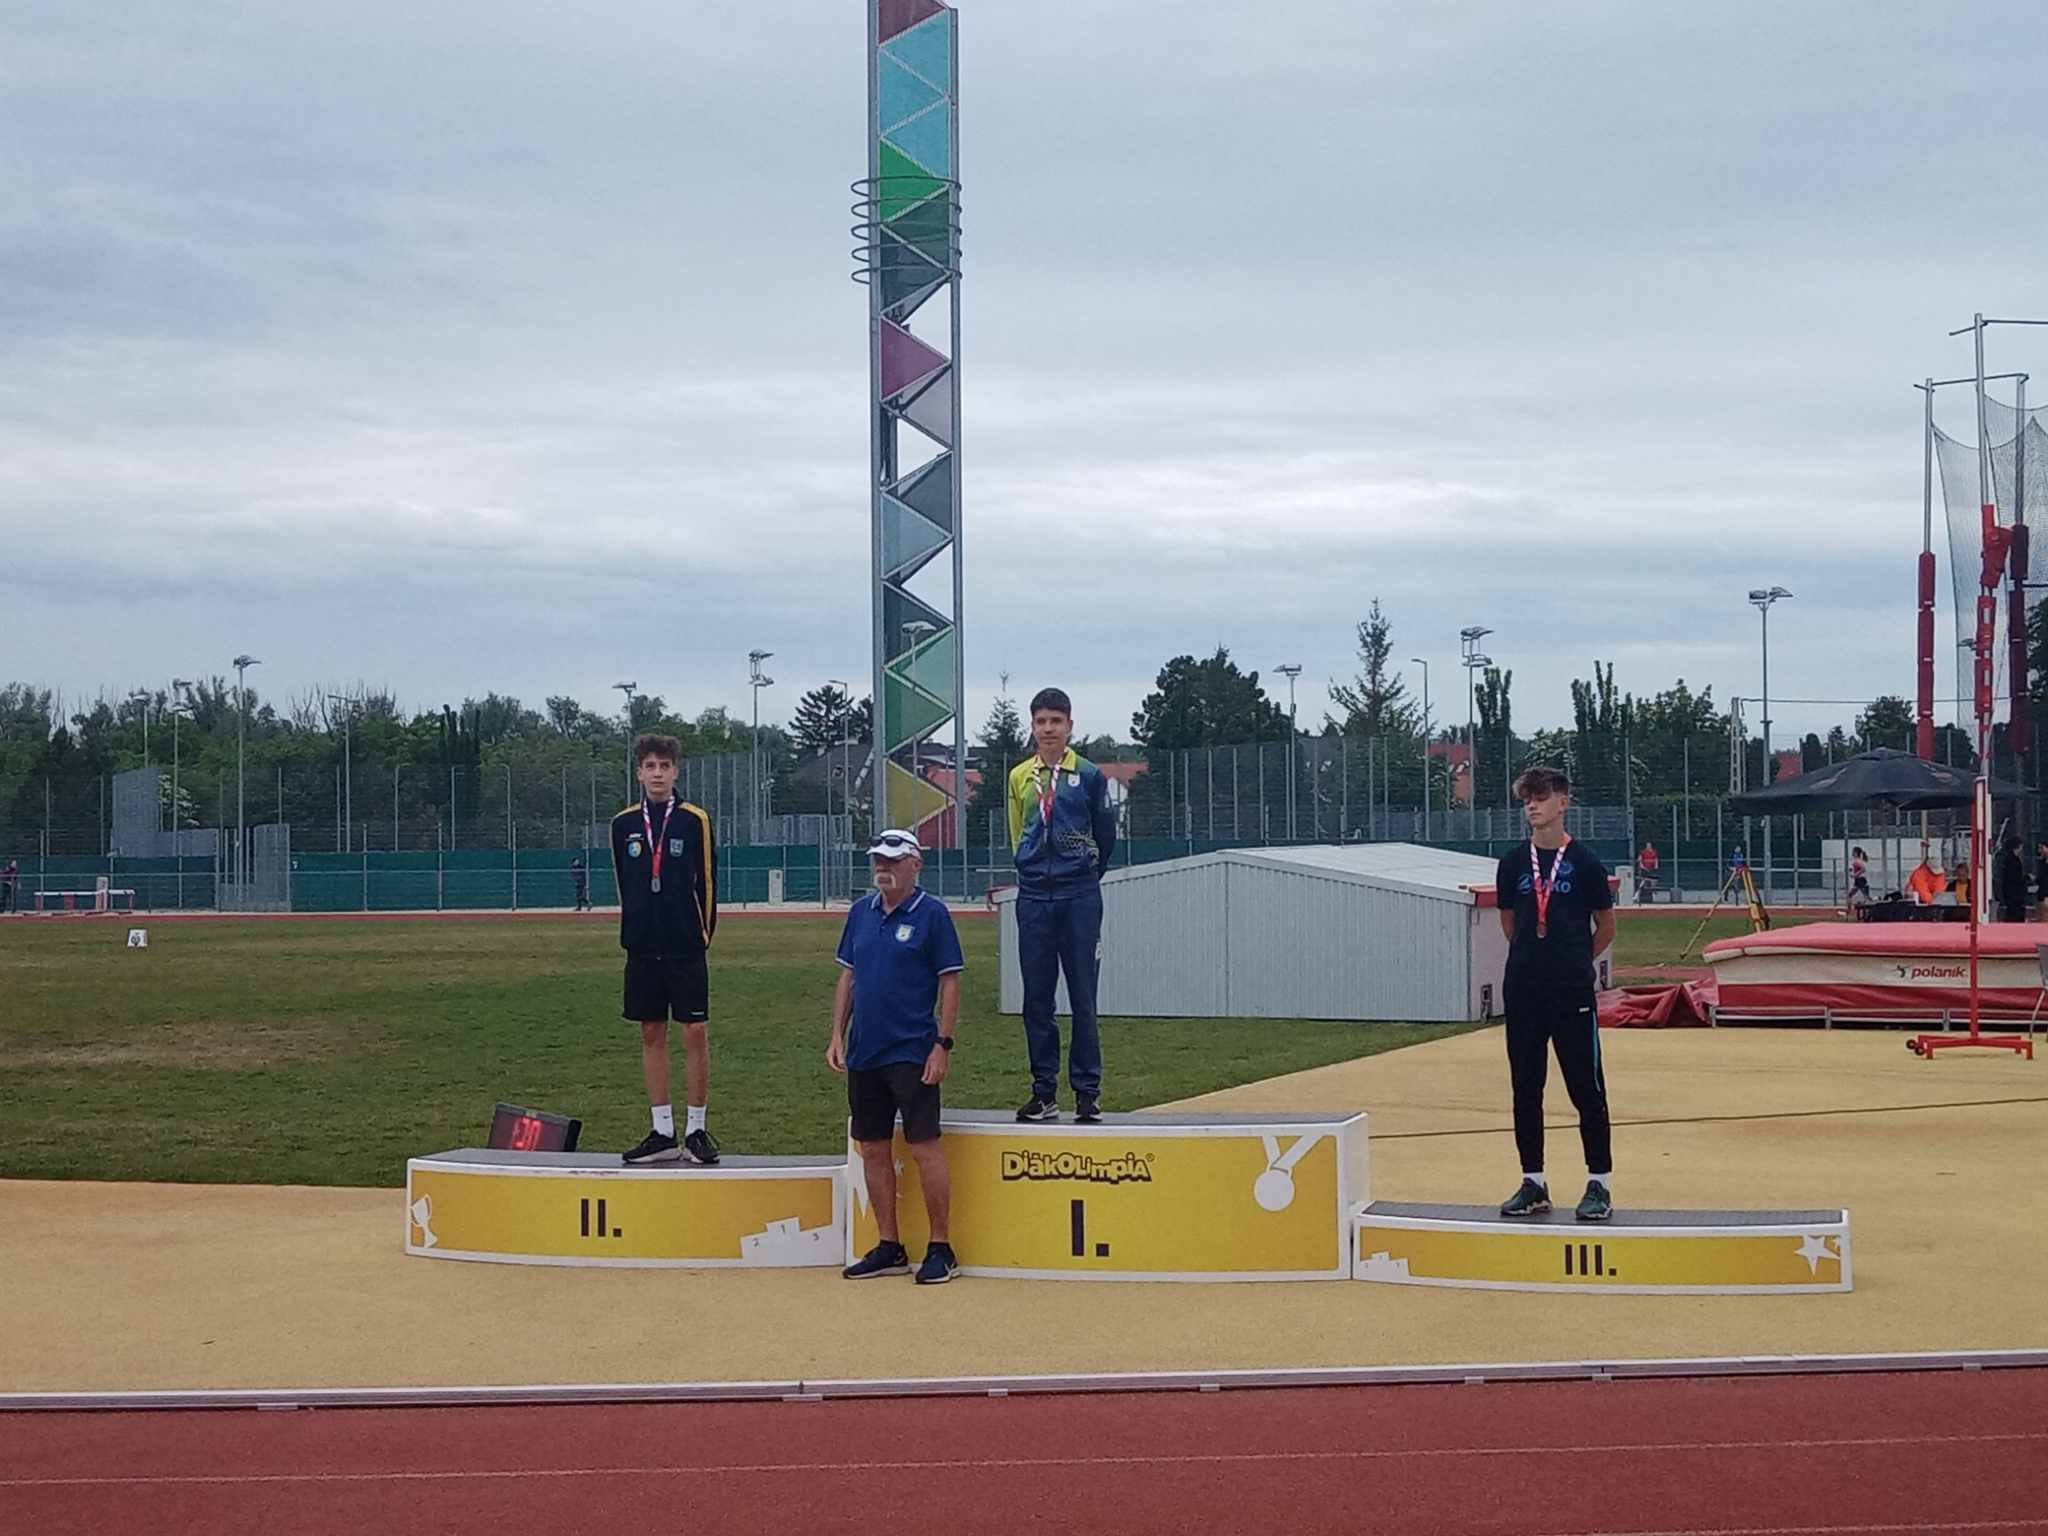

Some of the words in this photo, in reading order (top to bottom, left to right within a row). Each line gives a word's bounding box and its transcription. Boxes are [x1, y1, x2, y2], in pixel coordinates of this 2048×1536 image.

[1911, 966, 1966, 979] polanik
[580, 1199, 622, 1237] II.
[1071, 1199, 1109, 1256] I.
[1565, 1244, 1617, 1276] III.
